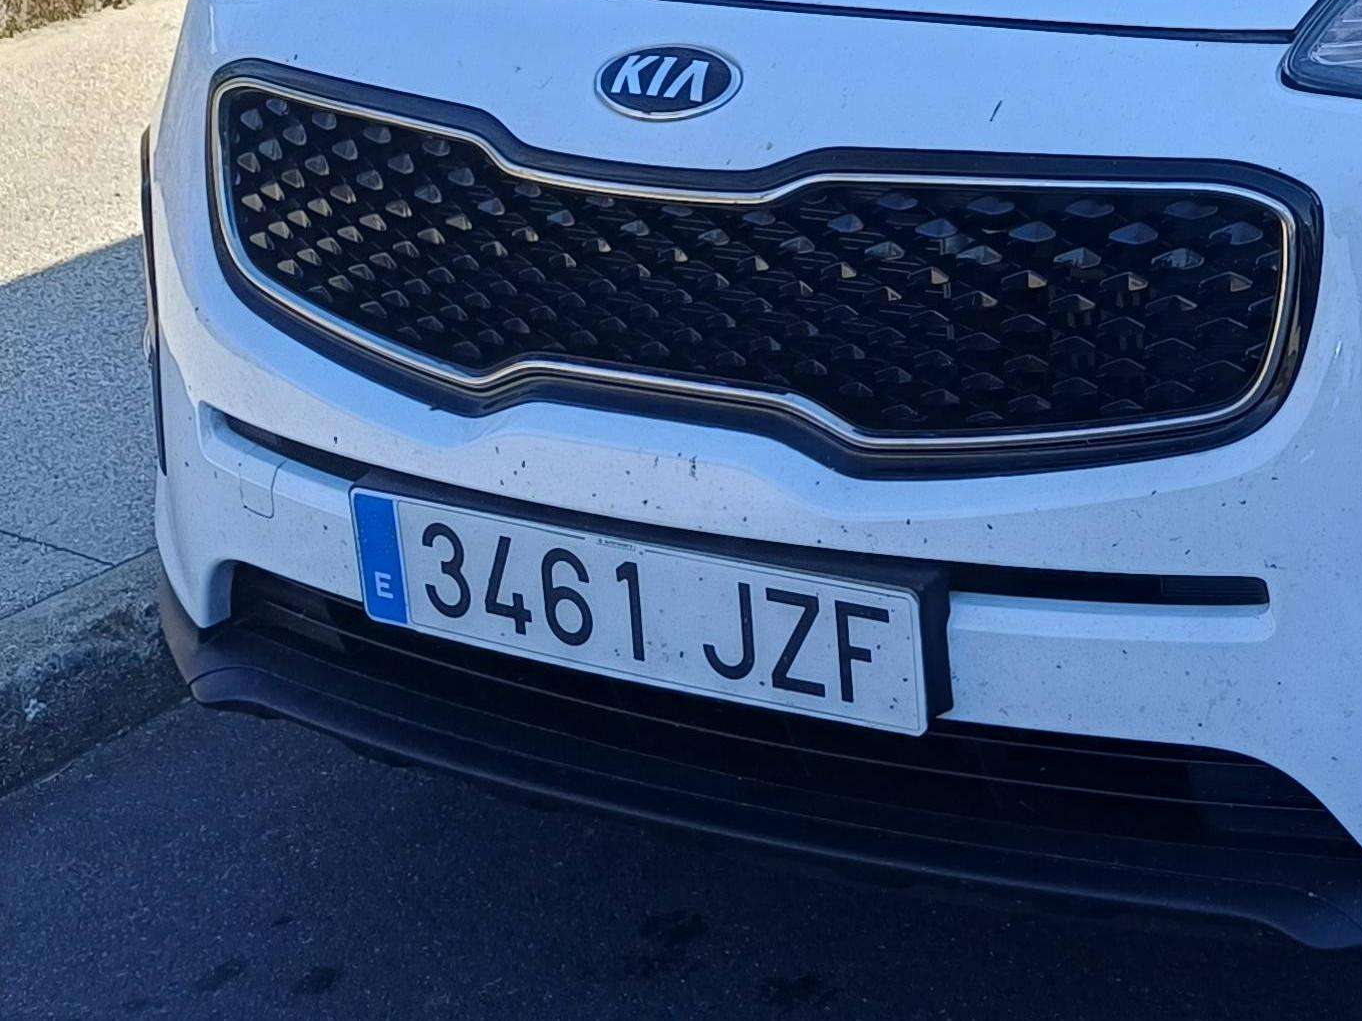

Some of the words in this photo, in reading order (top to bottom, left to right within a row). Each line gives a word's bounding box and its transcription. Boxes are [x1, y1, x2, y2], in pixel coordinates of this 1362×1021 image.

[610, 54, 710, 103] KIA
[374, 571, 394, 599] E
[421, 522, 645, 662] 3461
[702, 582, 890, 703] JZF
